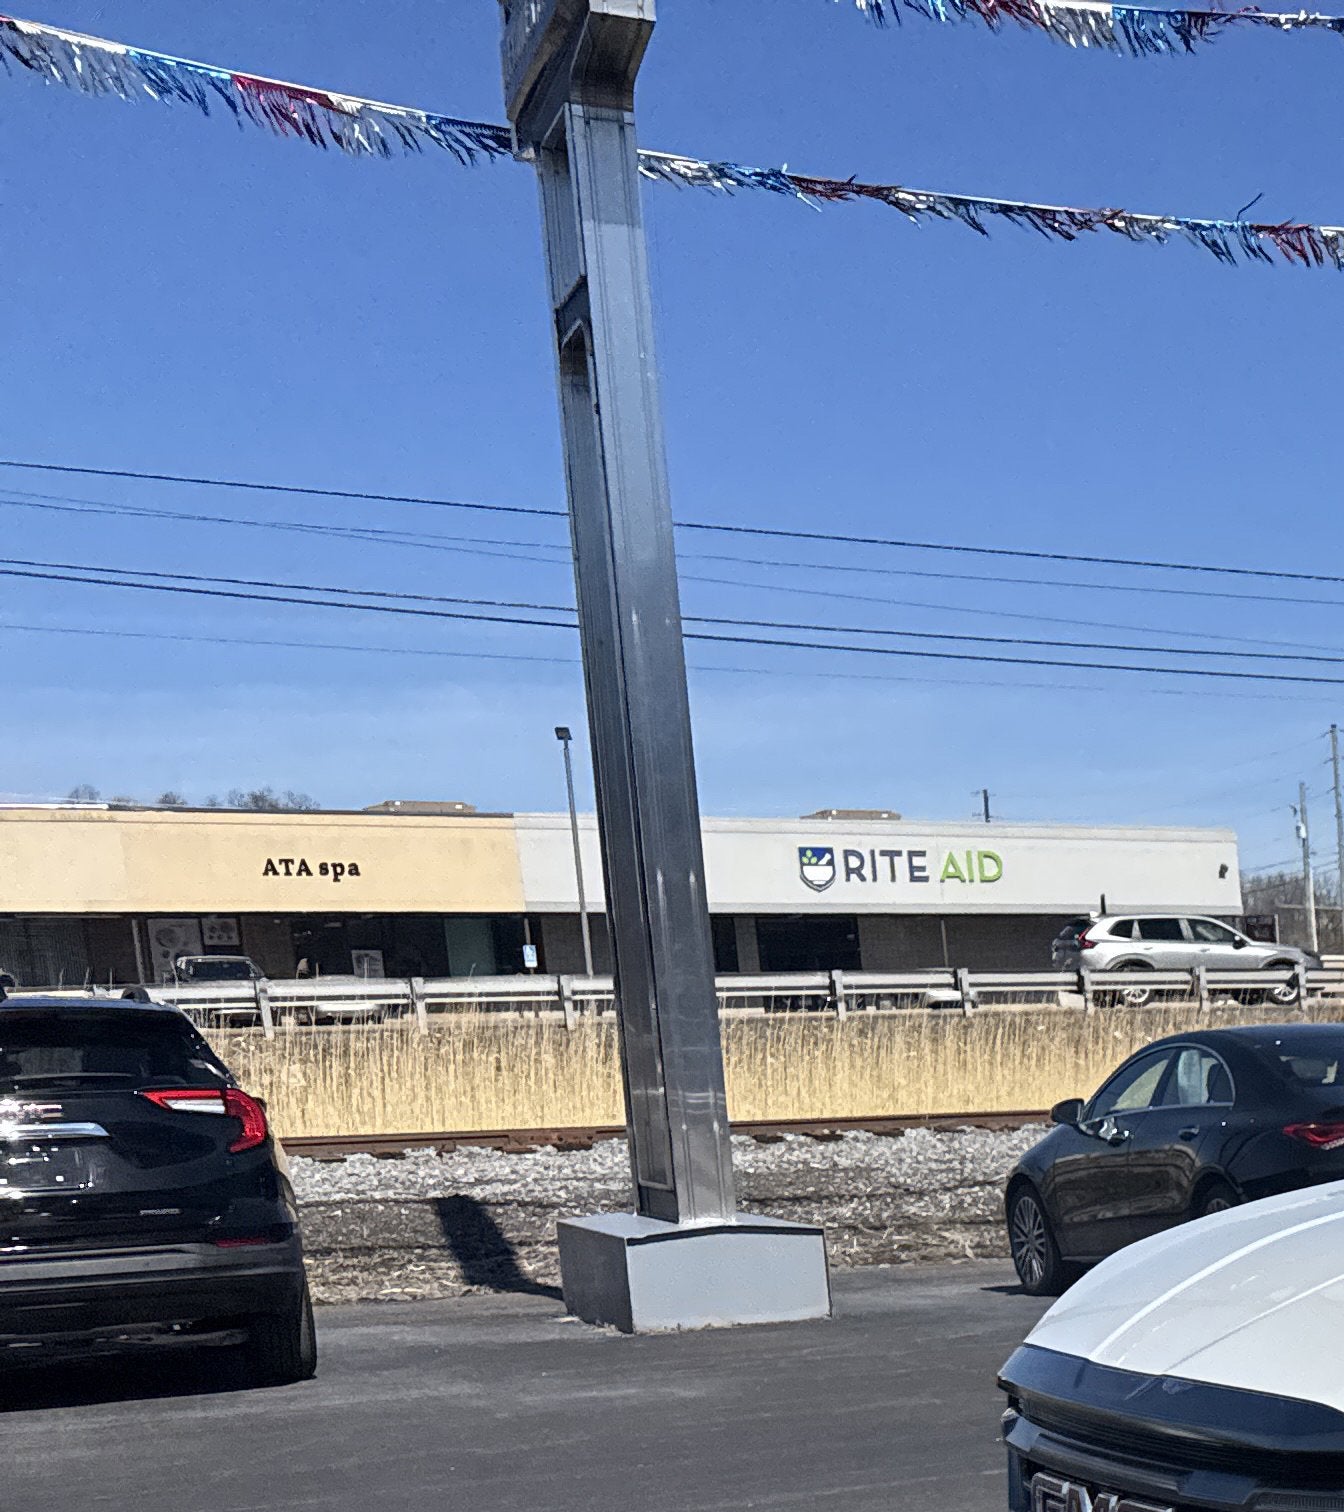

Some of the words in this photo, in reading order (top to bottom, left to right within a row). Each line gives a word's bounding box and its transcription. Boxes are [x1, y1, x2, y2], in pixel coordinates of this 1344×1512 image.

[262, 858, 313, 877] ATA
[318, 862, 361, 883] spa
[842, 848, 930, 883] RITE
[939, 849, 1003, 883] AID
